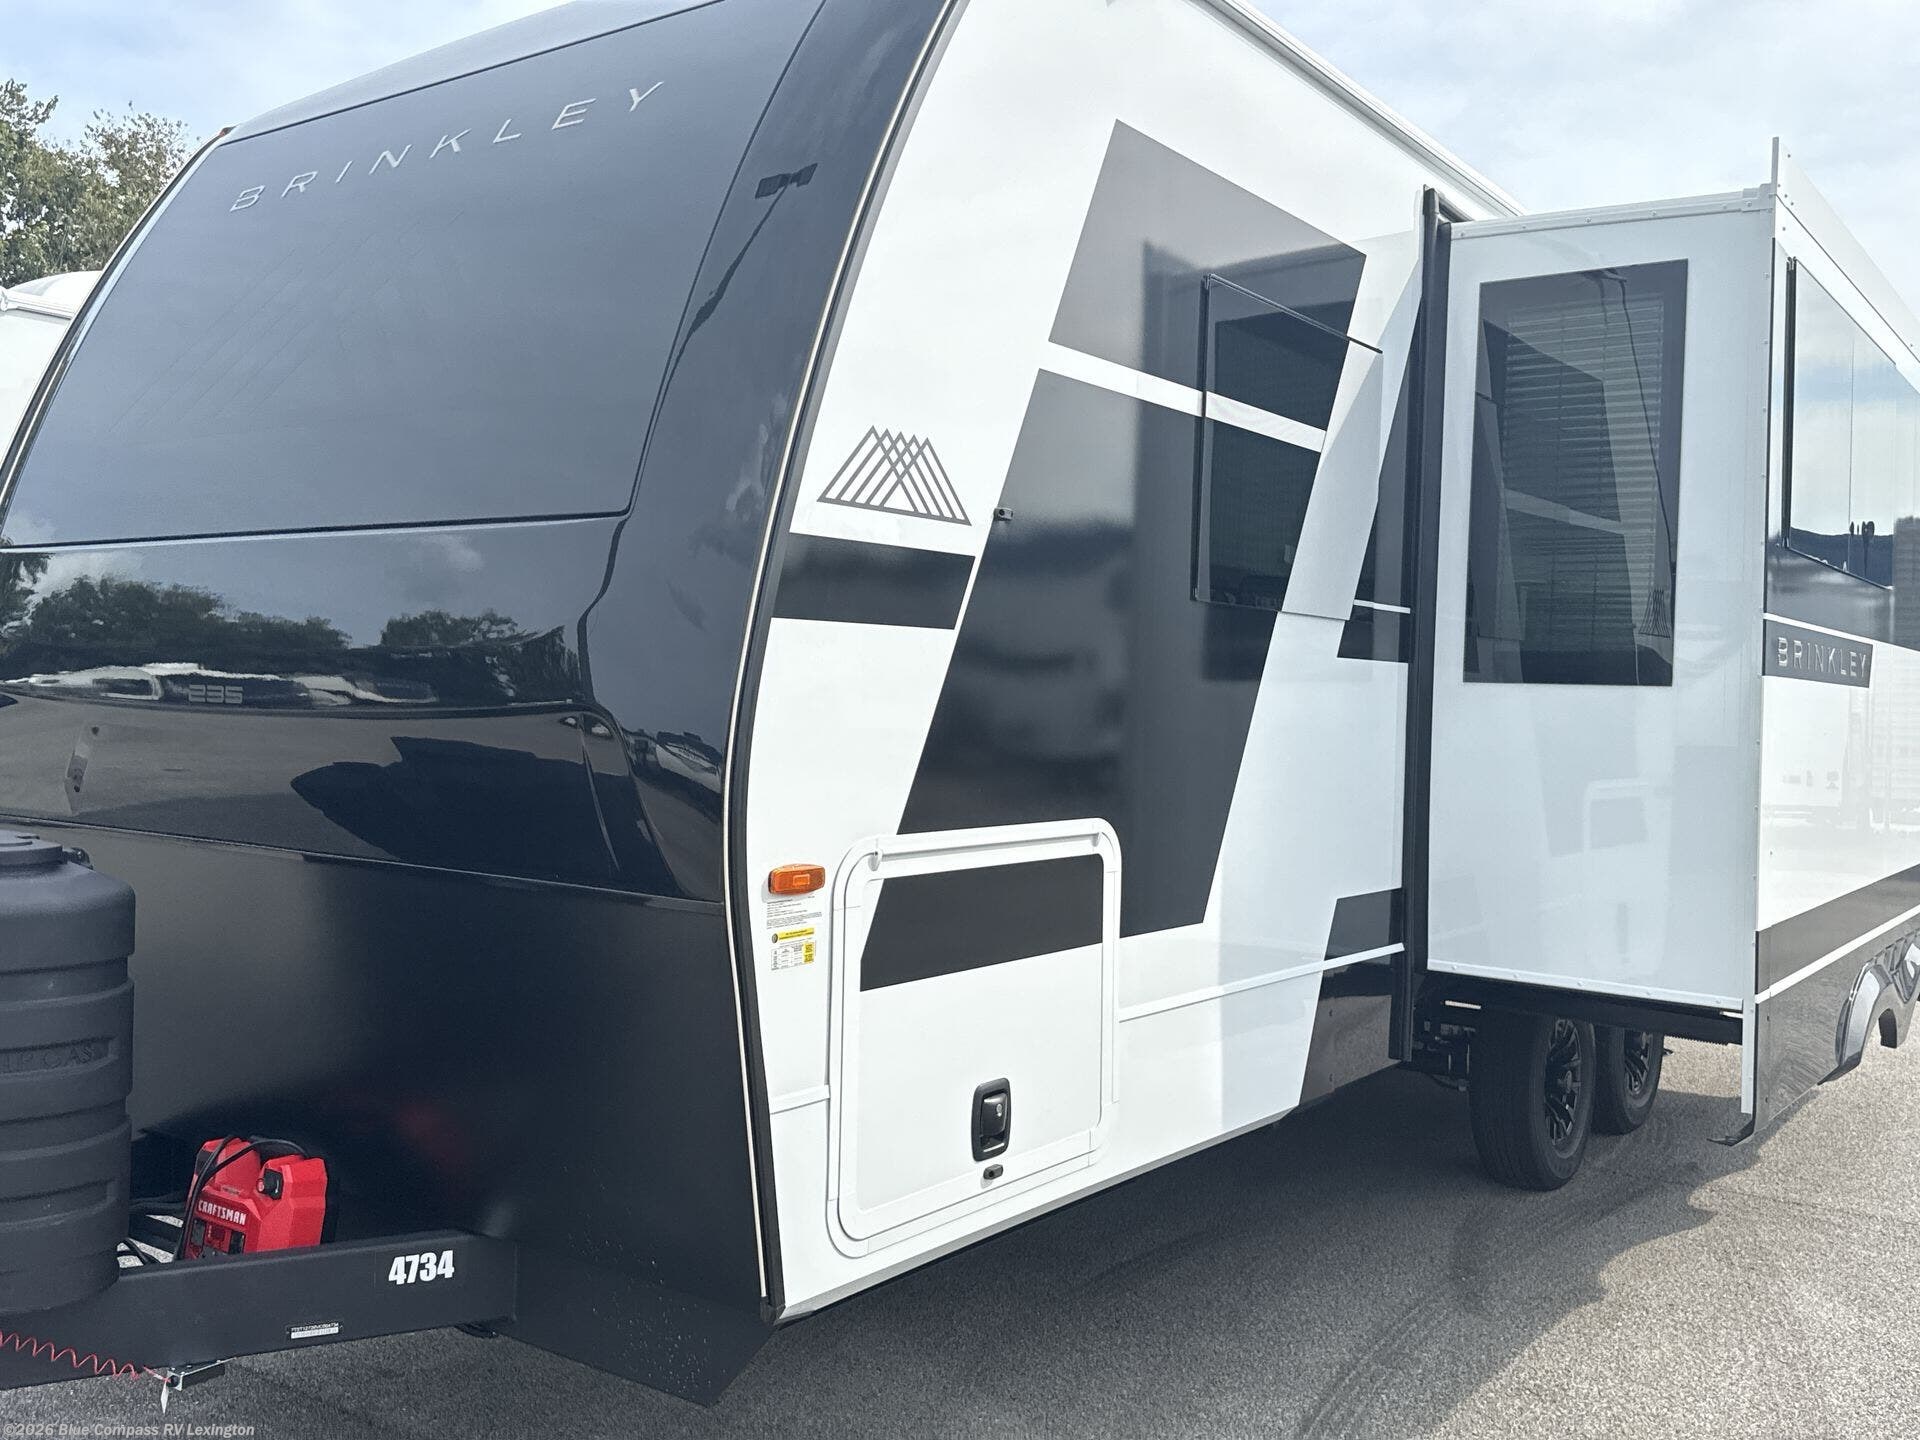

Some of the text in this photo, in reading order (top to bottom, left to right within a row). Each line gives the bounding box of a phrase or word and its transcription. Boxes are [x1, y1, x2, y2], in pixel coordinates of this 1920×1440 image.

[230, 81, 664, 212] BRINKLEY
[1777, 636, 1866, 678] BRINKLEY
[188, 684, 243, 704] 235
[198, 1200, 247, 1226] CRAFTSMAN
[388, 1250, 455, 1285] 4734
